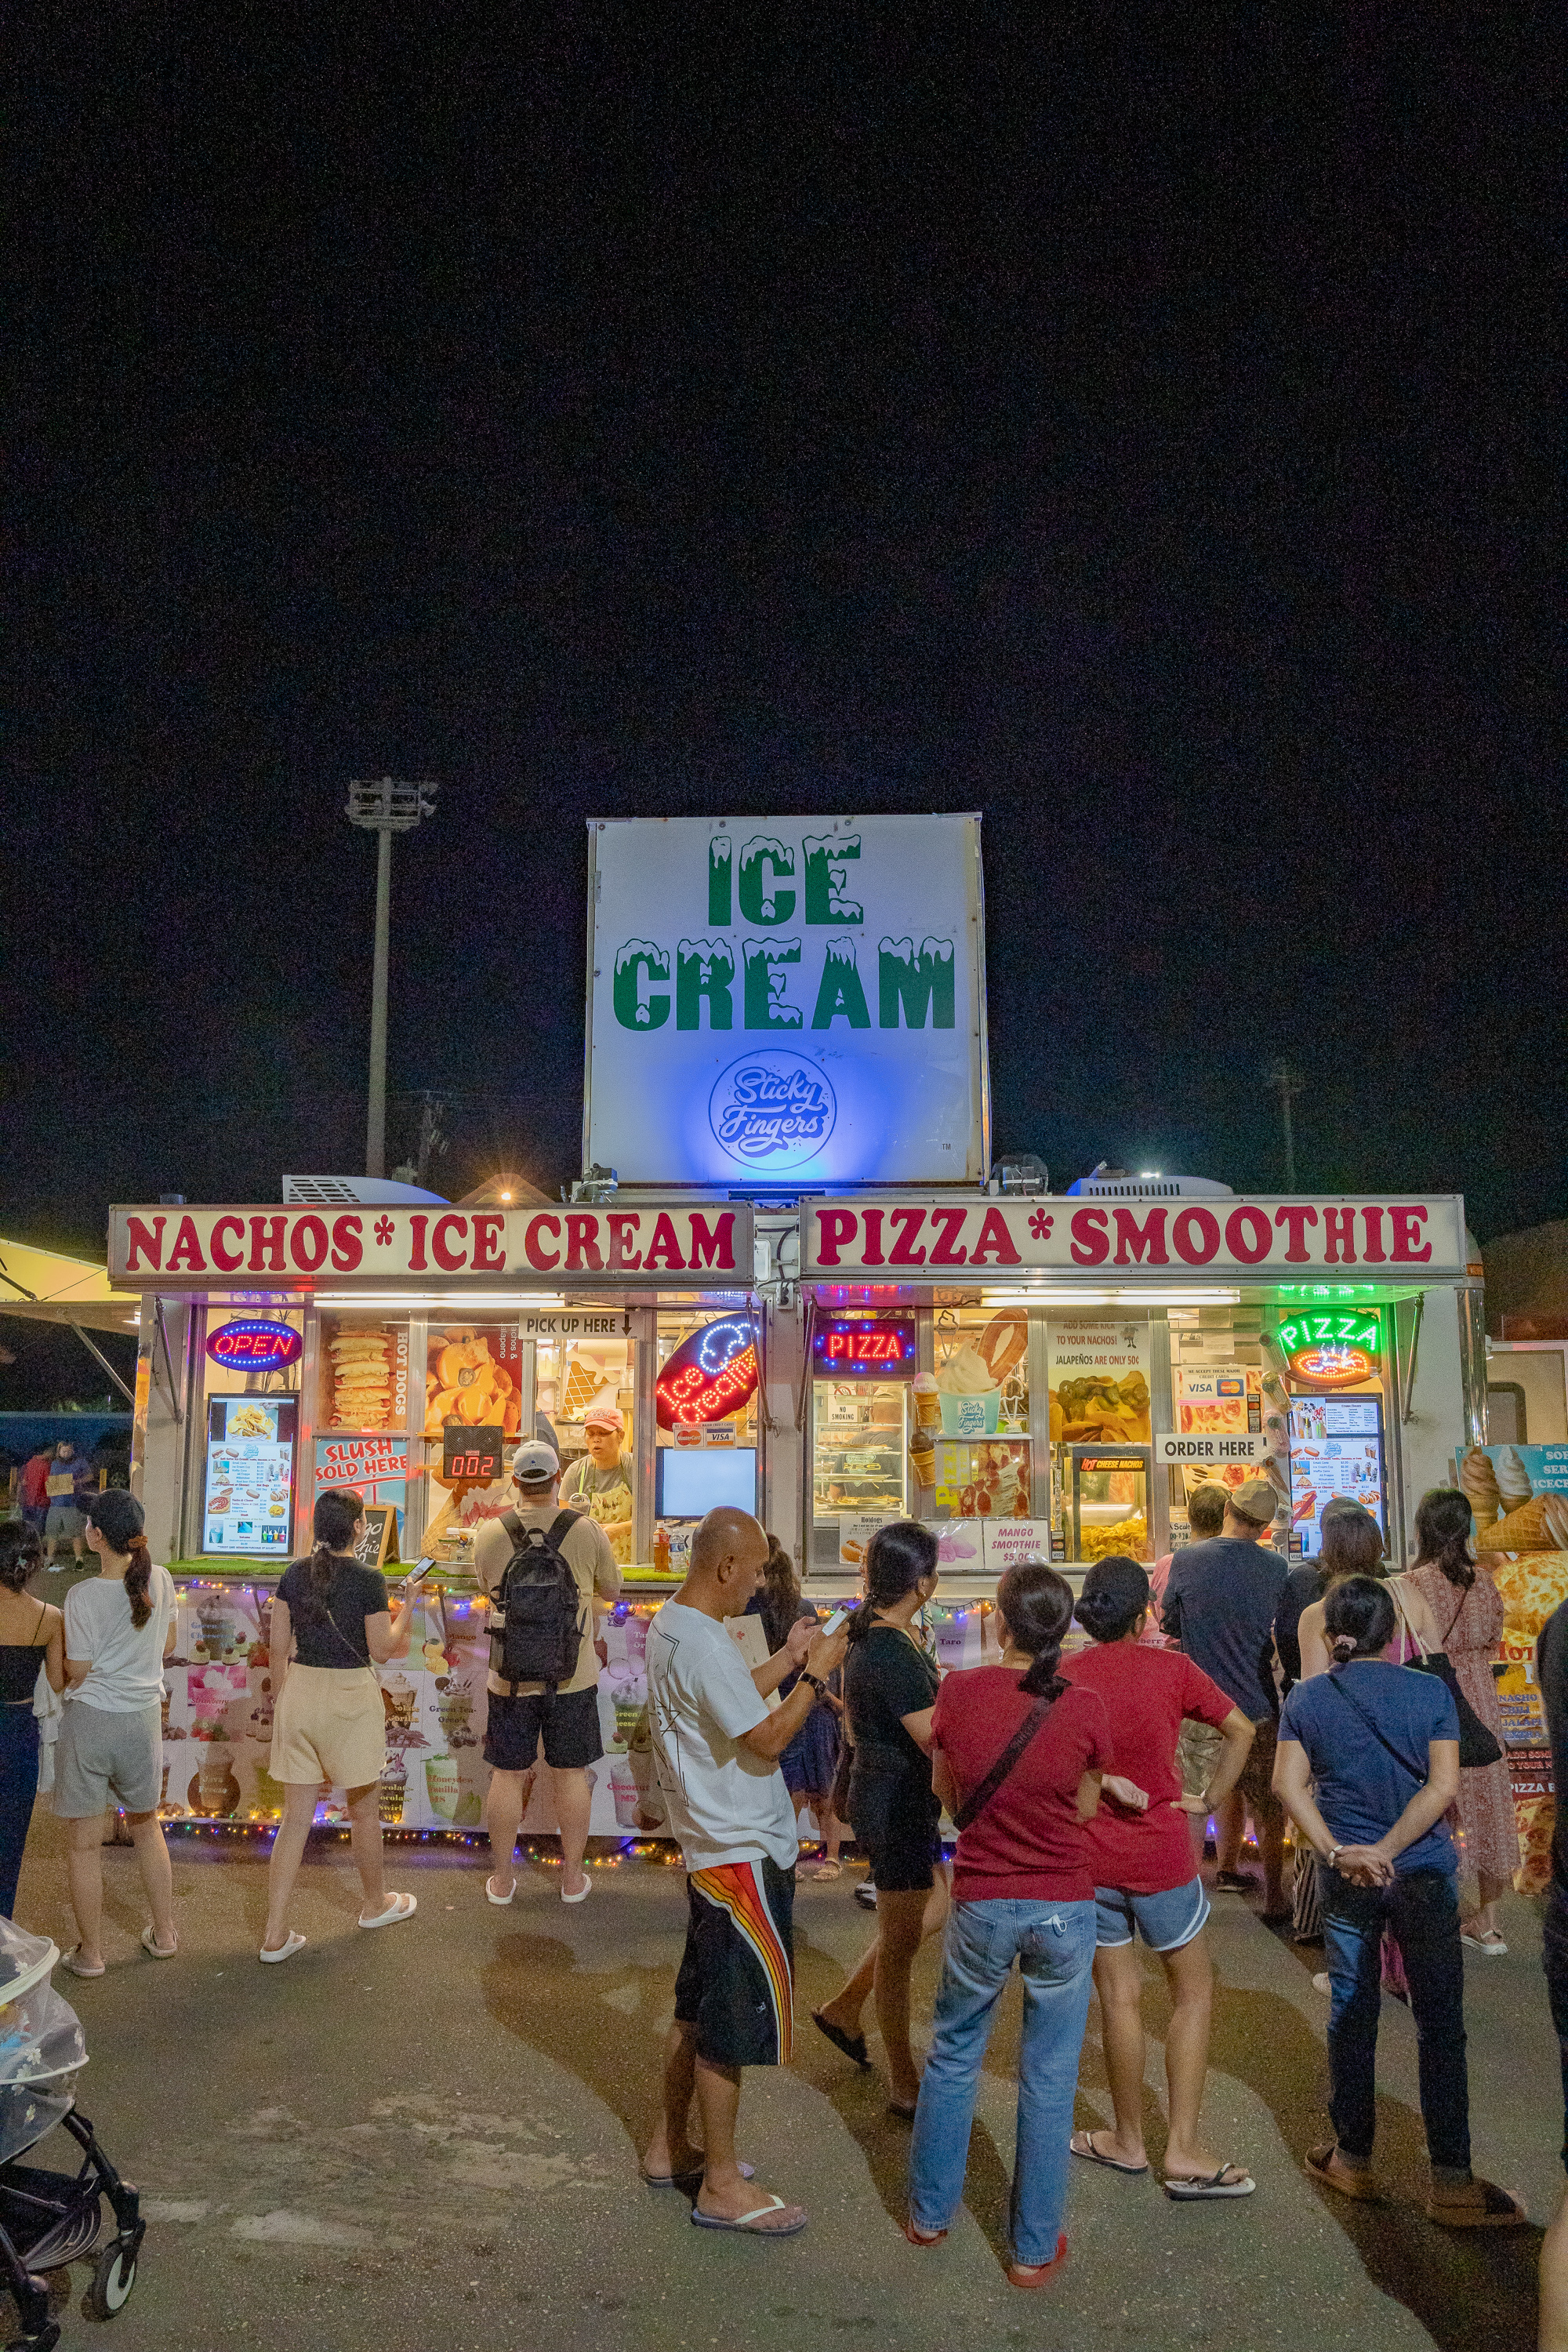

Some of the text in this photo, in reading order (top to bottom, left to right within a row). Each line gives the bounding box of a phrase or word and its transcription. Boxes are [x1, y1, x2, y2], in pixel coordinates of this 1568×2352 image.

[708, 834, 863, 926] ICE
[613, 937, 955, 1031] CREAM
[735, 1066, 826, 1115] Sticky
[719, 1104, 822, 1156] Fingers
[126, 1213, 736, 1272] NACHOS ICE CREAM
[815, 1205, 1432, 1266] PIZZA SMOOTHIE
[527, 1319, 615, 1332] PICK UP HERE
[1281, 1318, 1376, 1350] PIZZA
[215, 1335, 293, 1356] OPEN
[499, 1323, 508, 1359] alapeno
[830, 1335, 900, 1357] PIZZA
[1057, 1335, 1117, 1345] TO YOUR NACHOS!
[1056, 1354, 1093, 1364] JALAPEÑOS
[1094, 1356, 1107, 1364] ARE
[1109, 1356, 1126, 1364] ONLY
[395, 1332, 408, 1415] HOT DOGS
[657, 1367, 703, 1410] Ice
[961, 1401, 983, 1419] Sticky
[958, 1415, 983, 1434] Fingers
[326, 1438, 392, 1463] SLUSH
[1165, 1441, 1254, 1456] ORDER HERE
[316, 1455, 406, 1481] SOLD HERE
[452, 1457, 493, 1475] 002
[1082, 1458, 1098, 1471] HOT
[1544, 1465, 1568, 1474] SER
[998, 1528, 1033, 1537] MANGO
[992, 1541, 1040, 1549] SMOOTHIE
[1004, 1552, 1031, 1562] $5.00
[1529, 1750, 1552, 1759] SOM
[1510, 1783, 1545, 1792] PIZZA
